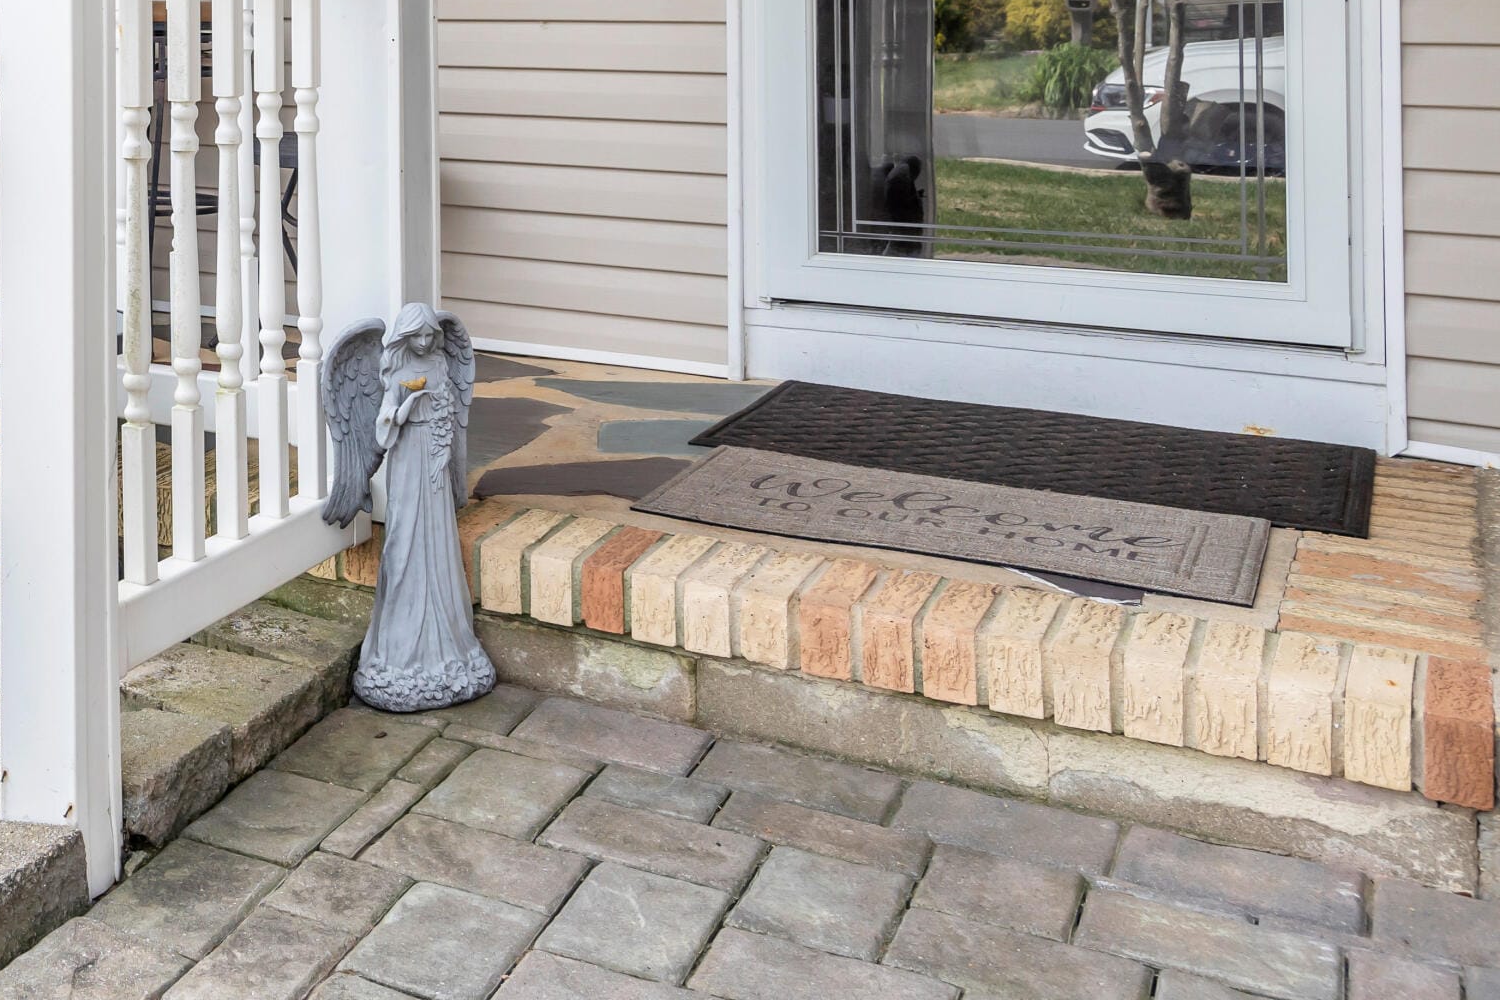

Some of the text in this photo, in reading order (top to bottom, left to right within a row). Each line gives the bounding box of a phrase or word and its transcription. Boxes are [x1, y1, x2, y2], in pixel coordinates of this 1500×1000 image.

[750, 474, 1186, 548] Welcome
[750, 496, 1157, 564] TO OUR HOME
